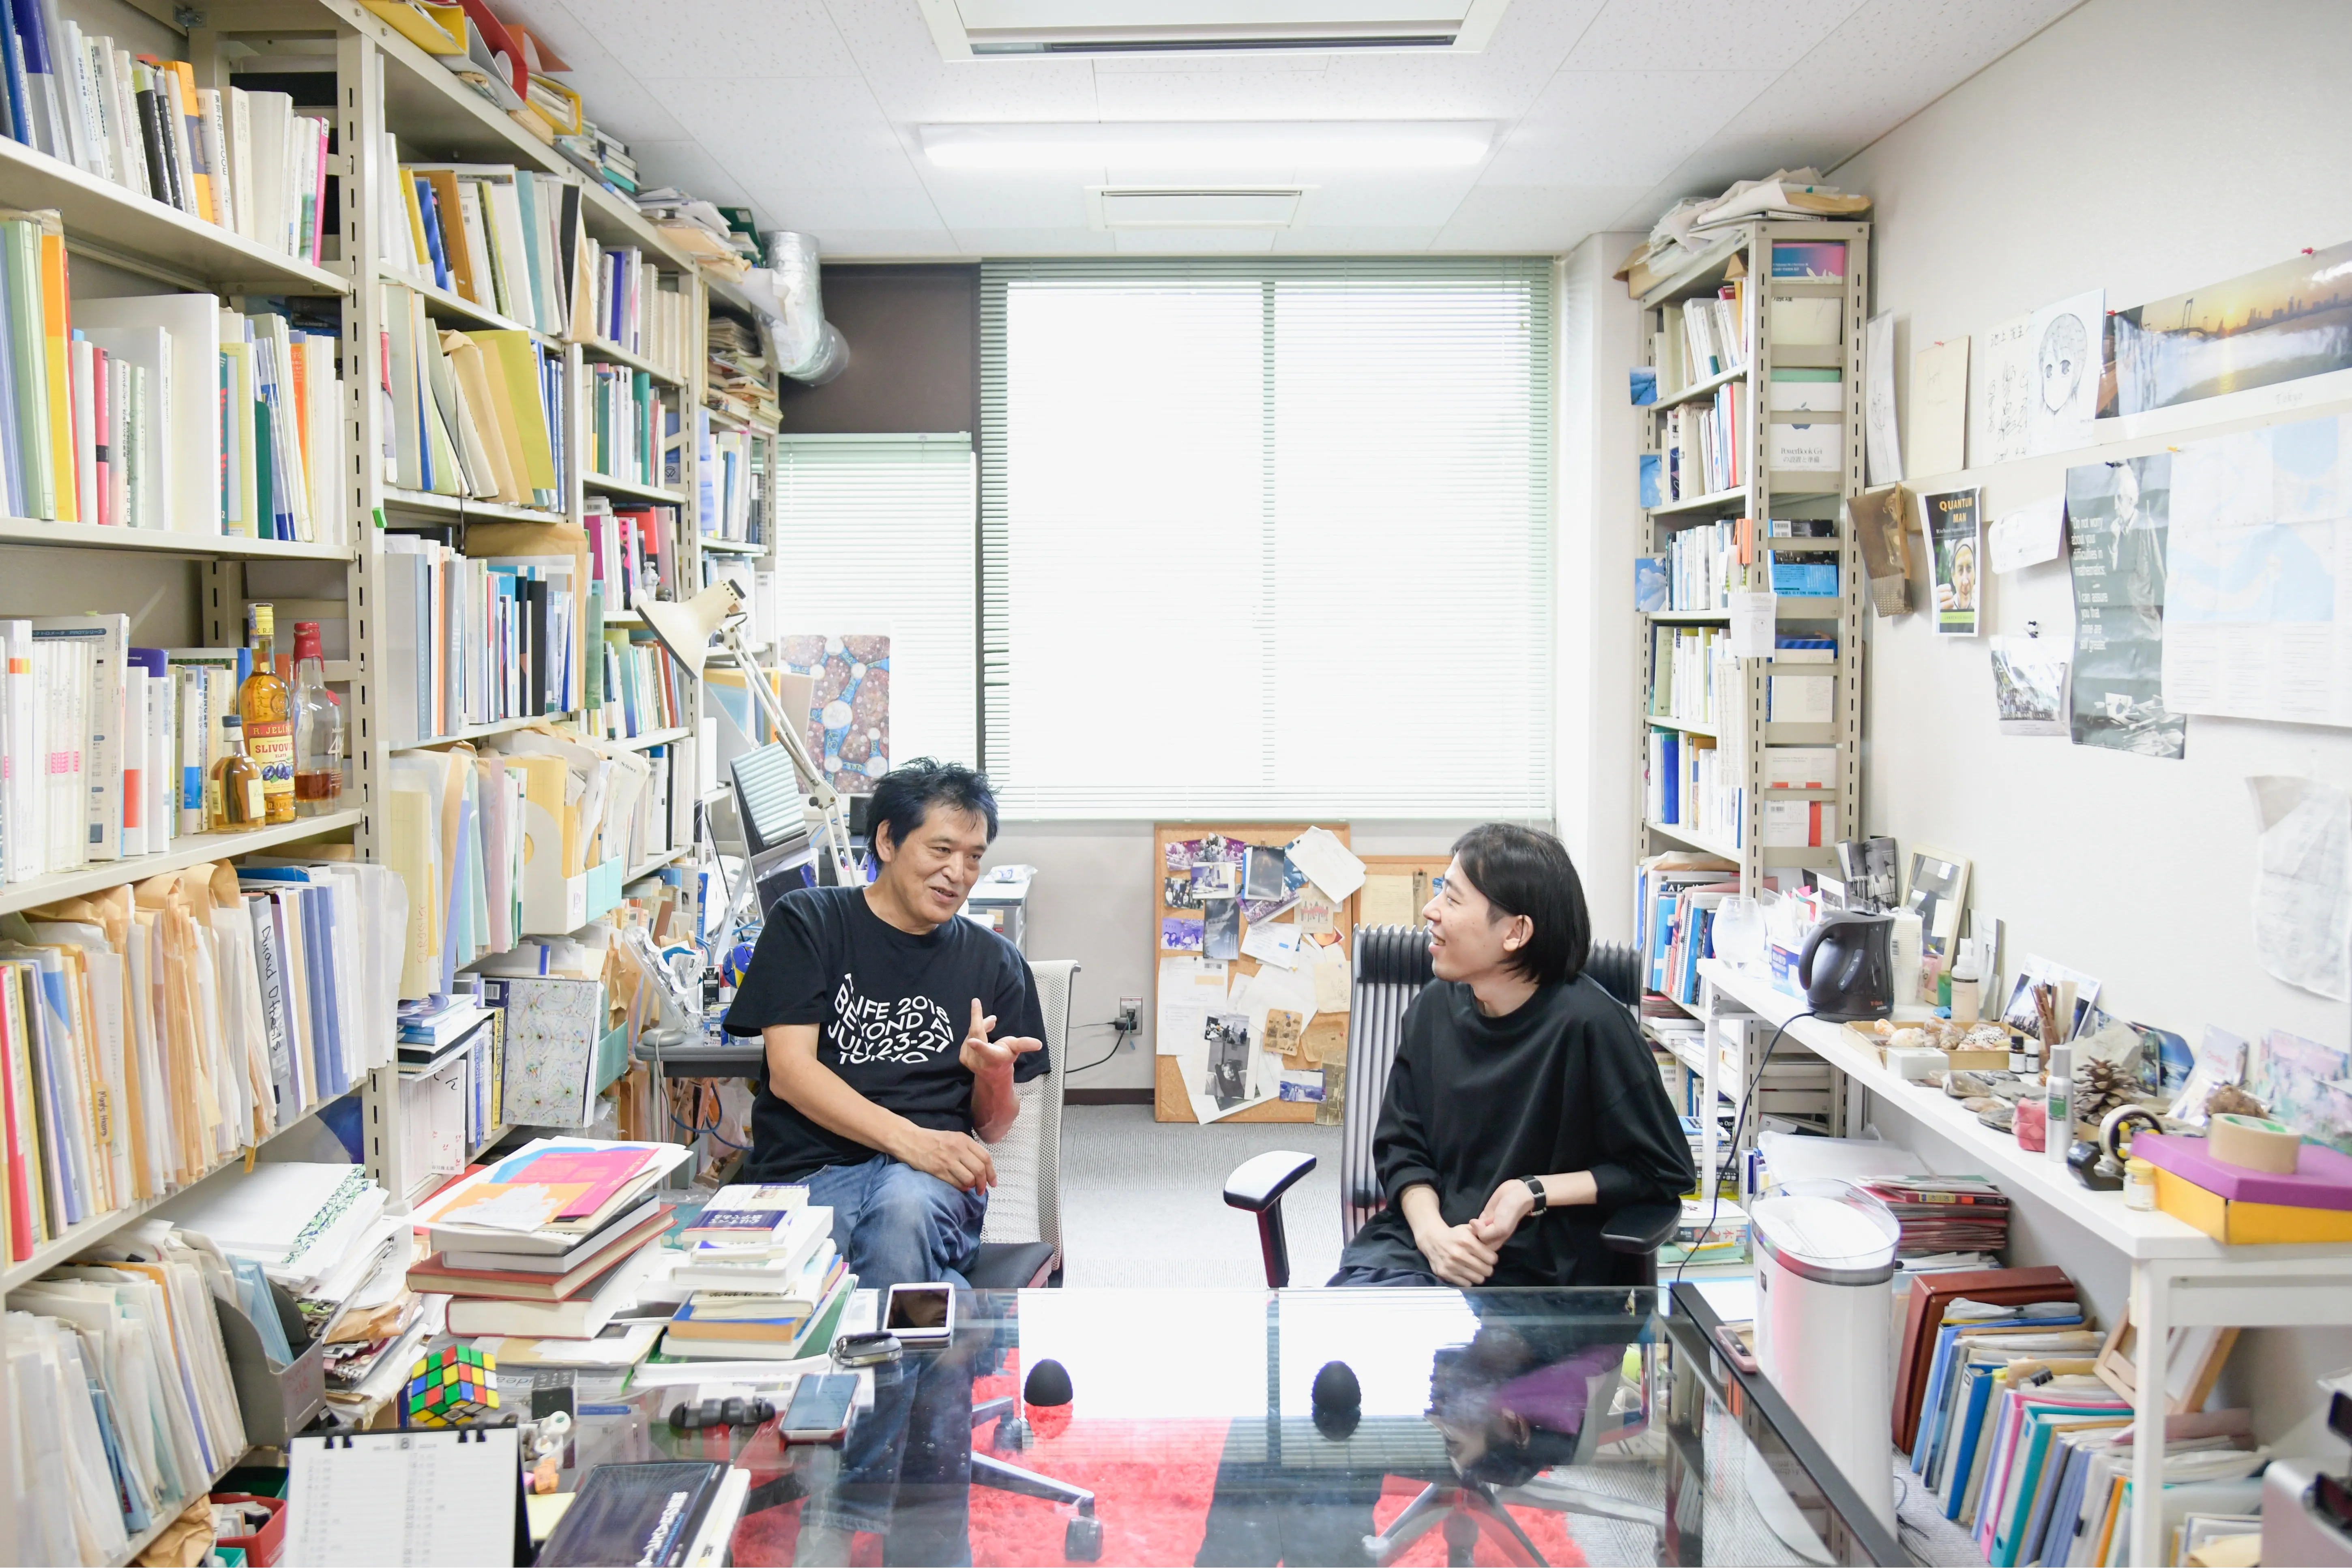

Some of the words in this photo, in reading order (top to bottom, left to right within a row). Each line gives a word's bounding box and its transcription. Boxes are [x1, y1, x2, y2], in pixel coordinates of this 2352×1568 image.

[1939, 497, 1972, 512] QUANTUM
[1953, 512, 1967, 523] MAN
[2080, 518, 2089, 529] not
[2089, 517, 2104, 530] worry
[2071, 534, 2085, 545] about
[2085, 535, 2096, 547] your
[2081, 593, 2091, 603] can
[2091, 592, 2108, 603] assure
[2080, 609, 2090, 621] you
[266, 724, 292, 734] JELÍN
[834, 983, 923, 1037] BEYOND
[931, 1017, 954, 1042] AI
[895, 995, 950, 1024] 2018
[827, 1019, 873, 1055] JULY
[877, 1030, 950, 1056] 23-27
[839, 1051, 929, 1064] TOKYO
